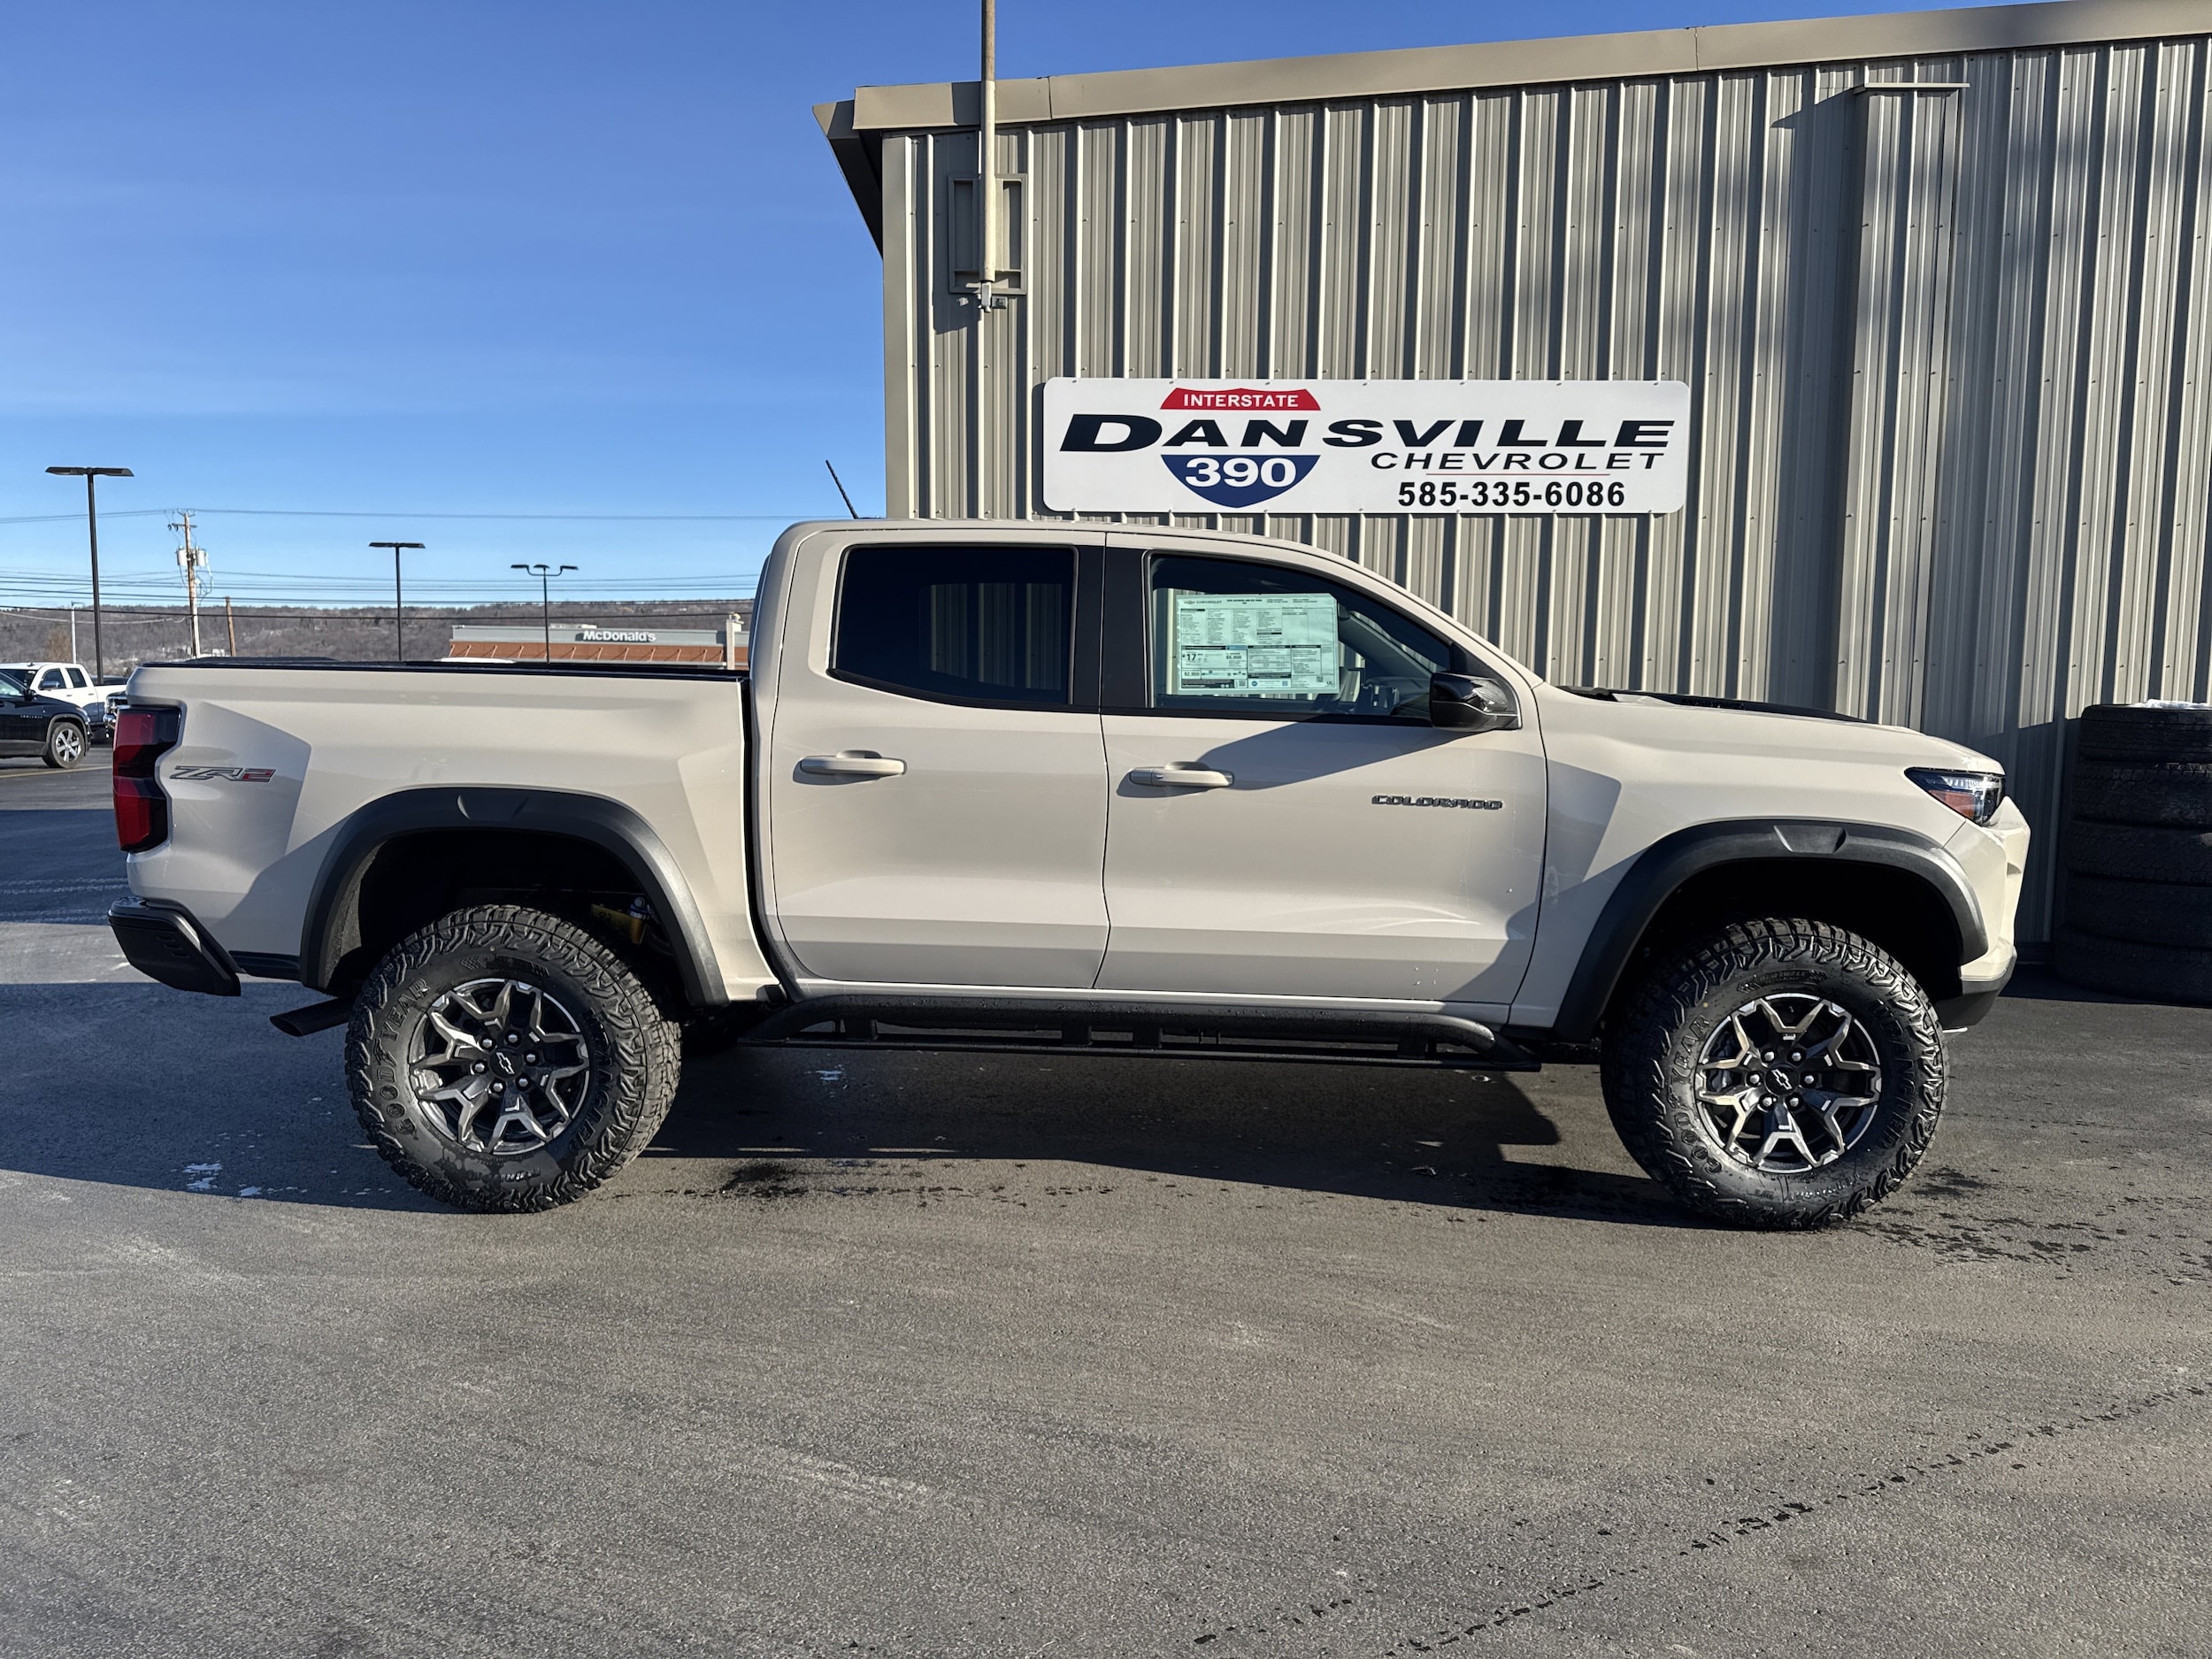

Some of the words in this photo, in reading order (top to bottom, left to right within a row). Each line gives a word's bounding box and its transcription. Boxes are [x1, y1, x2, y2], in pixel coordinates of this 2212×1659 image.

[1183, 393, 1300, 408] INTERSTATE
[1371, 451, 1664, 471] CHEVROLET
[1184, 457, 1298, 488] 390
[1397, 480, 1625, 507] 585-335-6086
[583, 630, 657, 642] McDonald's
[170, 765, 276, 783] ZR2
[1371, 795, 1503, 810] COLORADO
